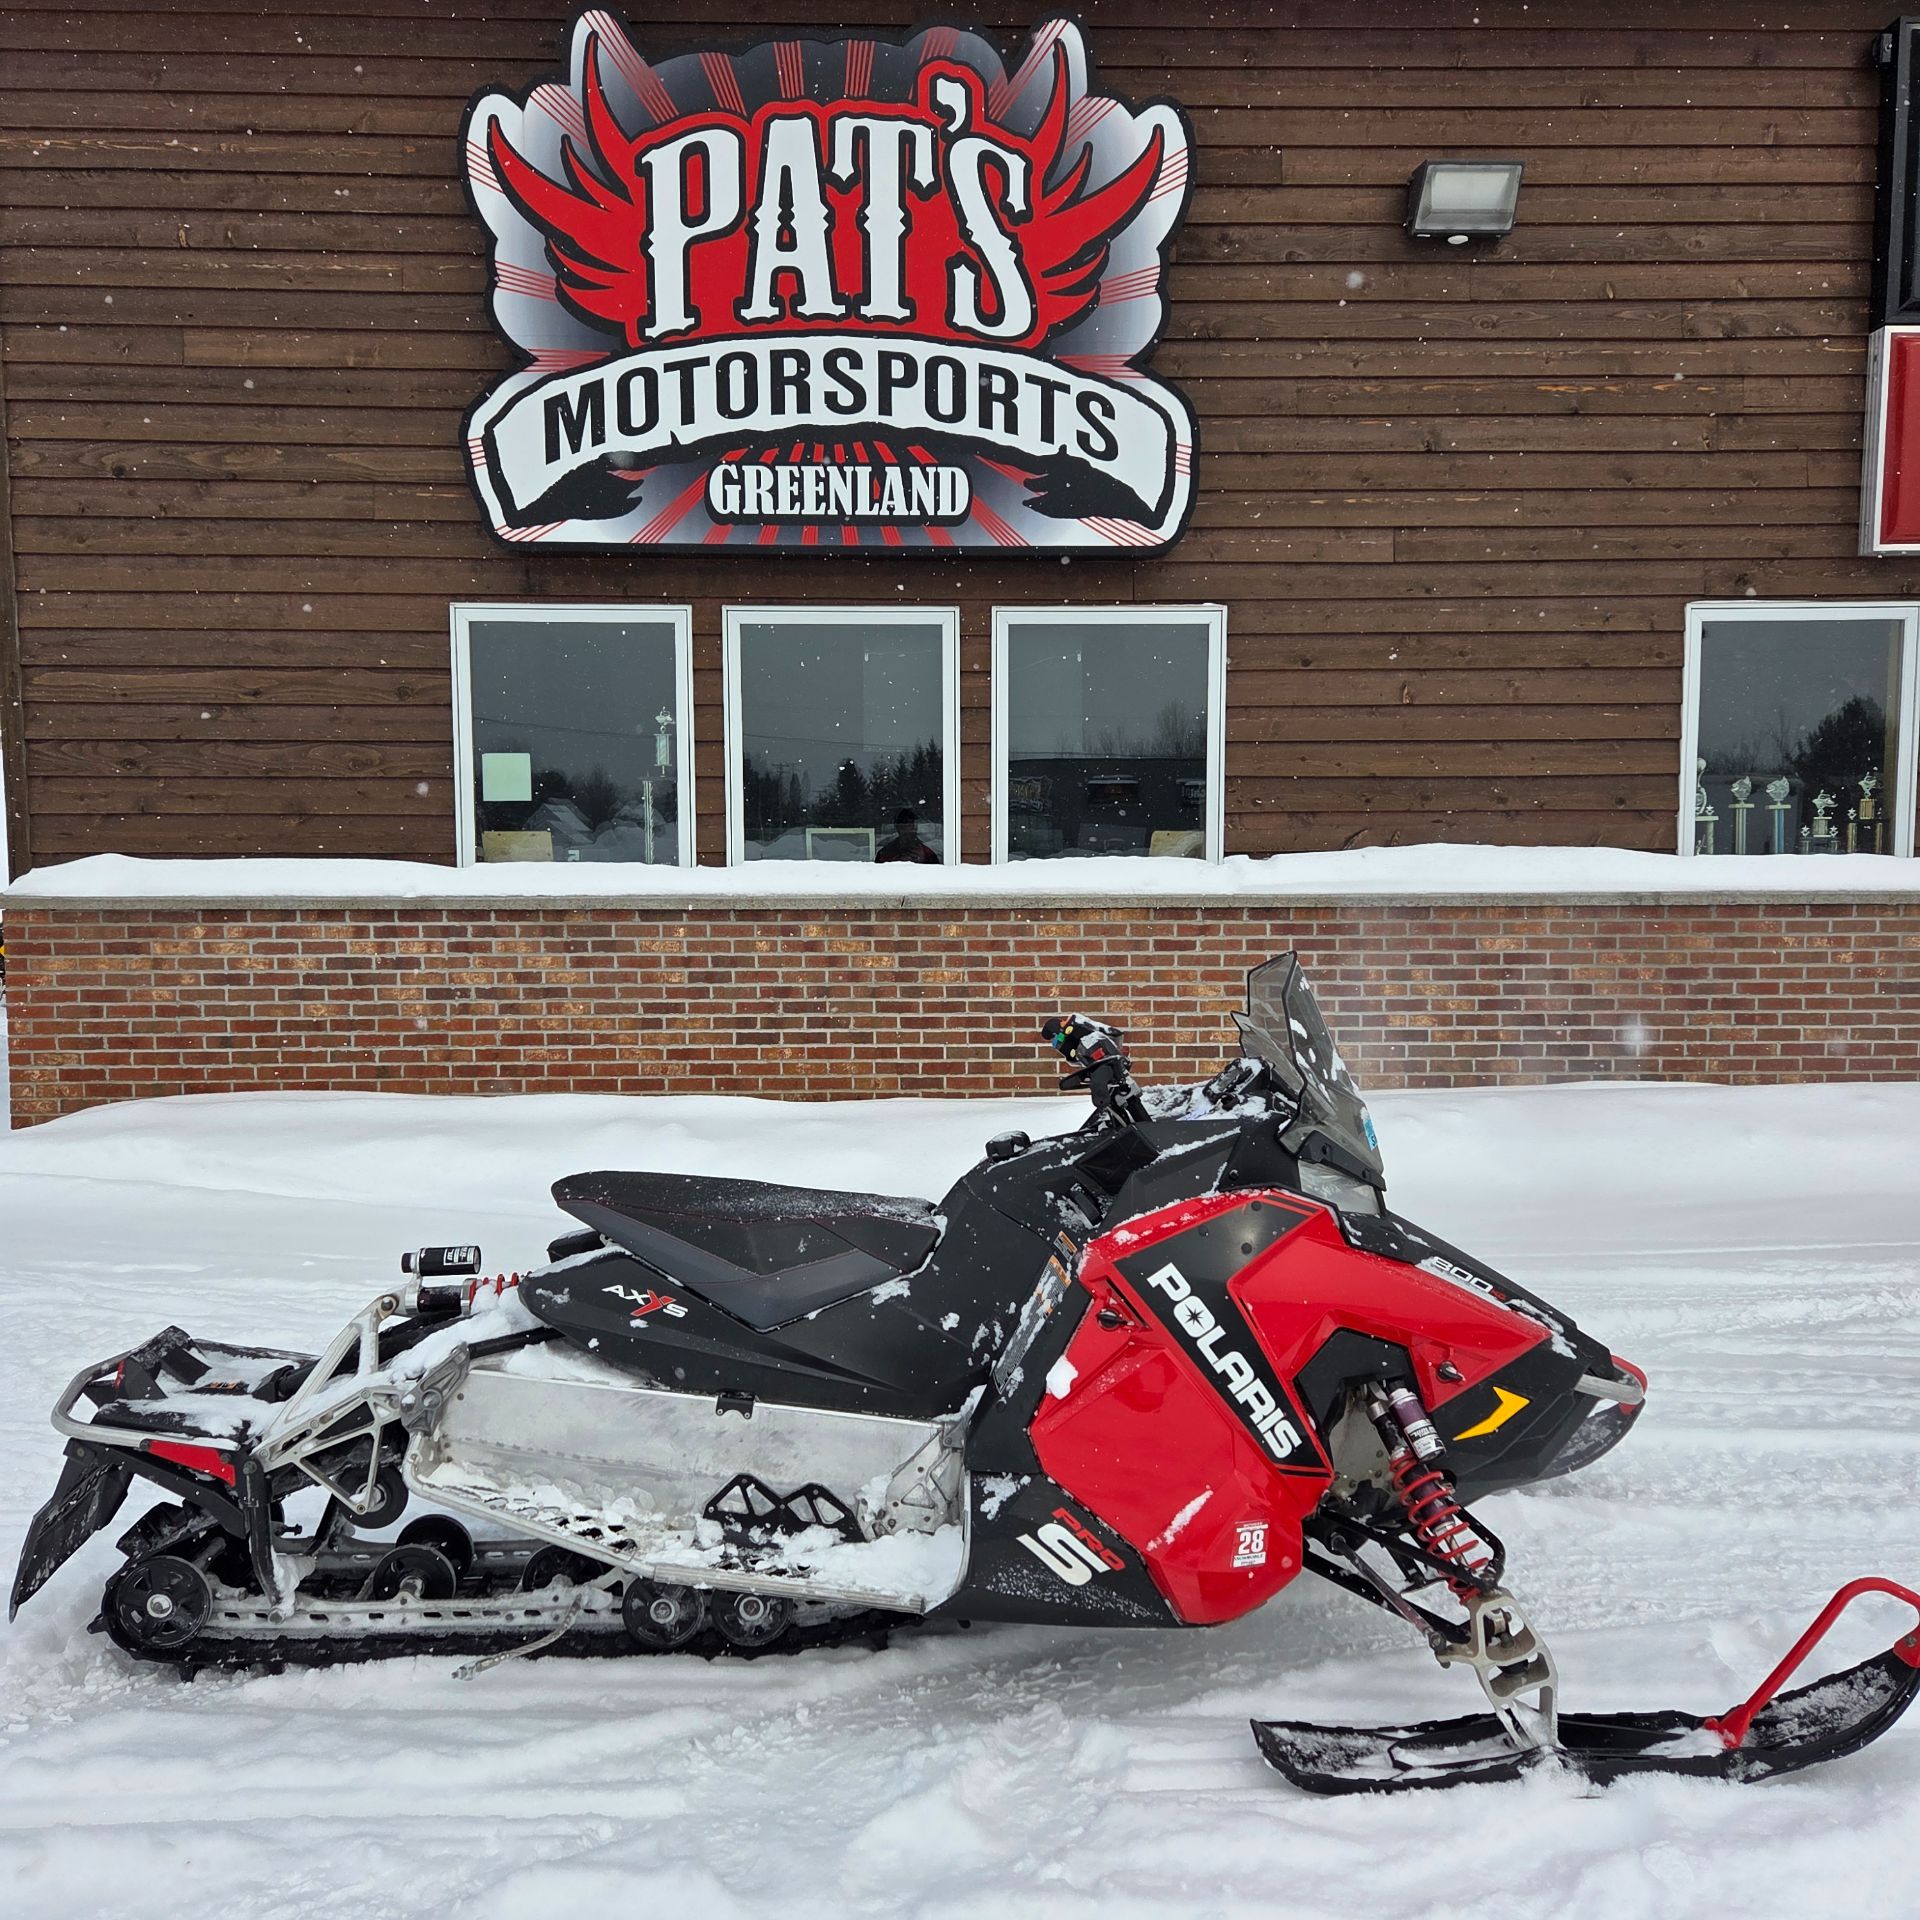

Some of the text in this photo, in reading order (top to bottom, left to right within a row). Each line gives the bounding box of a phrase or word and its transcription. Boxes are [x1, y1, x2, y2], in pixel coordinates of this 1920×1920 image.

[641, 77, 1032, 339] PAT'S
[541, 348, 1119, 465] MOTORSPORTS
[709, 464, 970, 518] GREENLAND
[601, 1285, 689, 1318] AXYS
[1431, 1256, 1494, 1294] 800
[1146, 1262, 1303, 1459] POLARIS
[1051, 1507, 1126, 1572] PRO
[1238, 1529, 1264, 1555] 28
